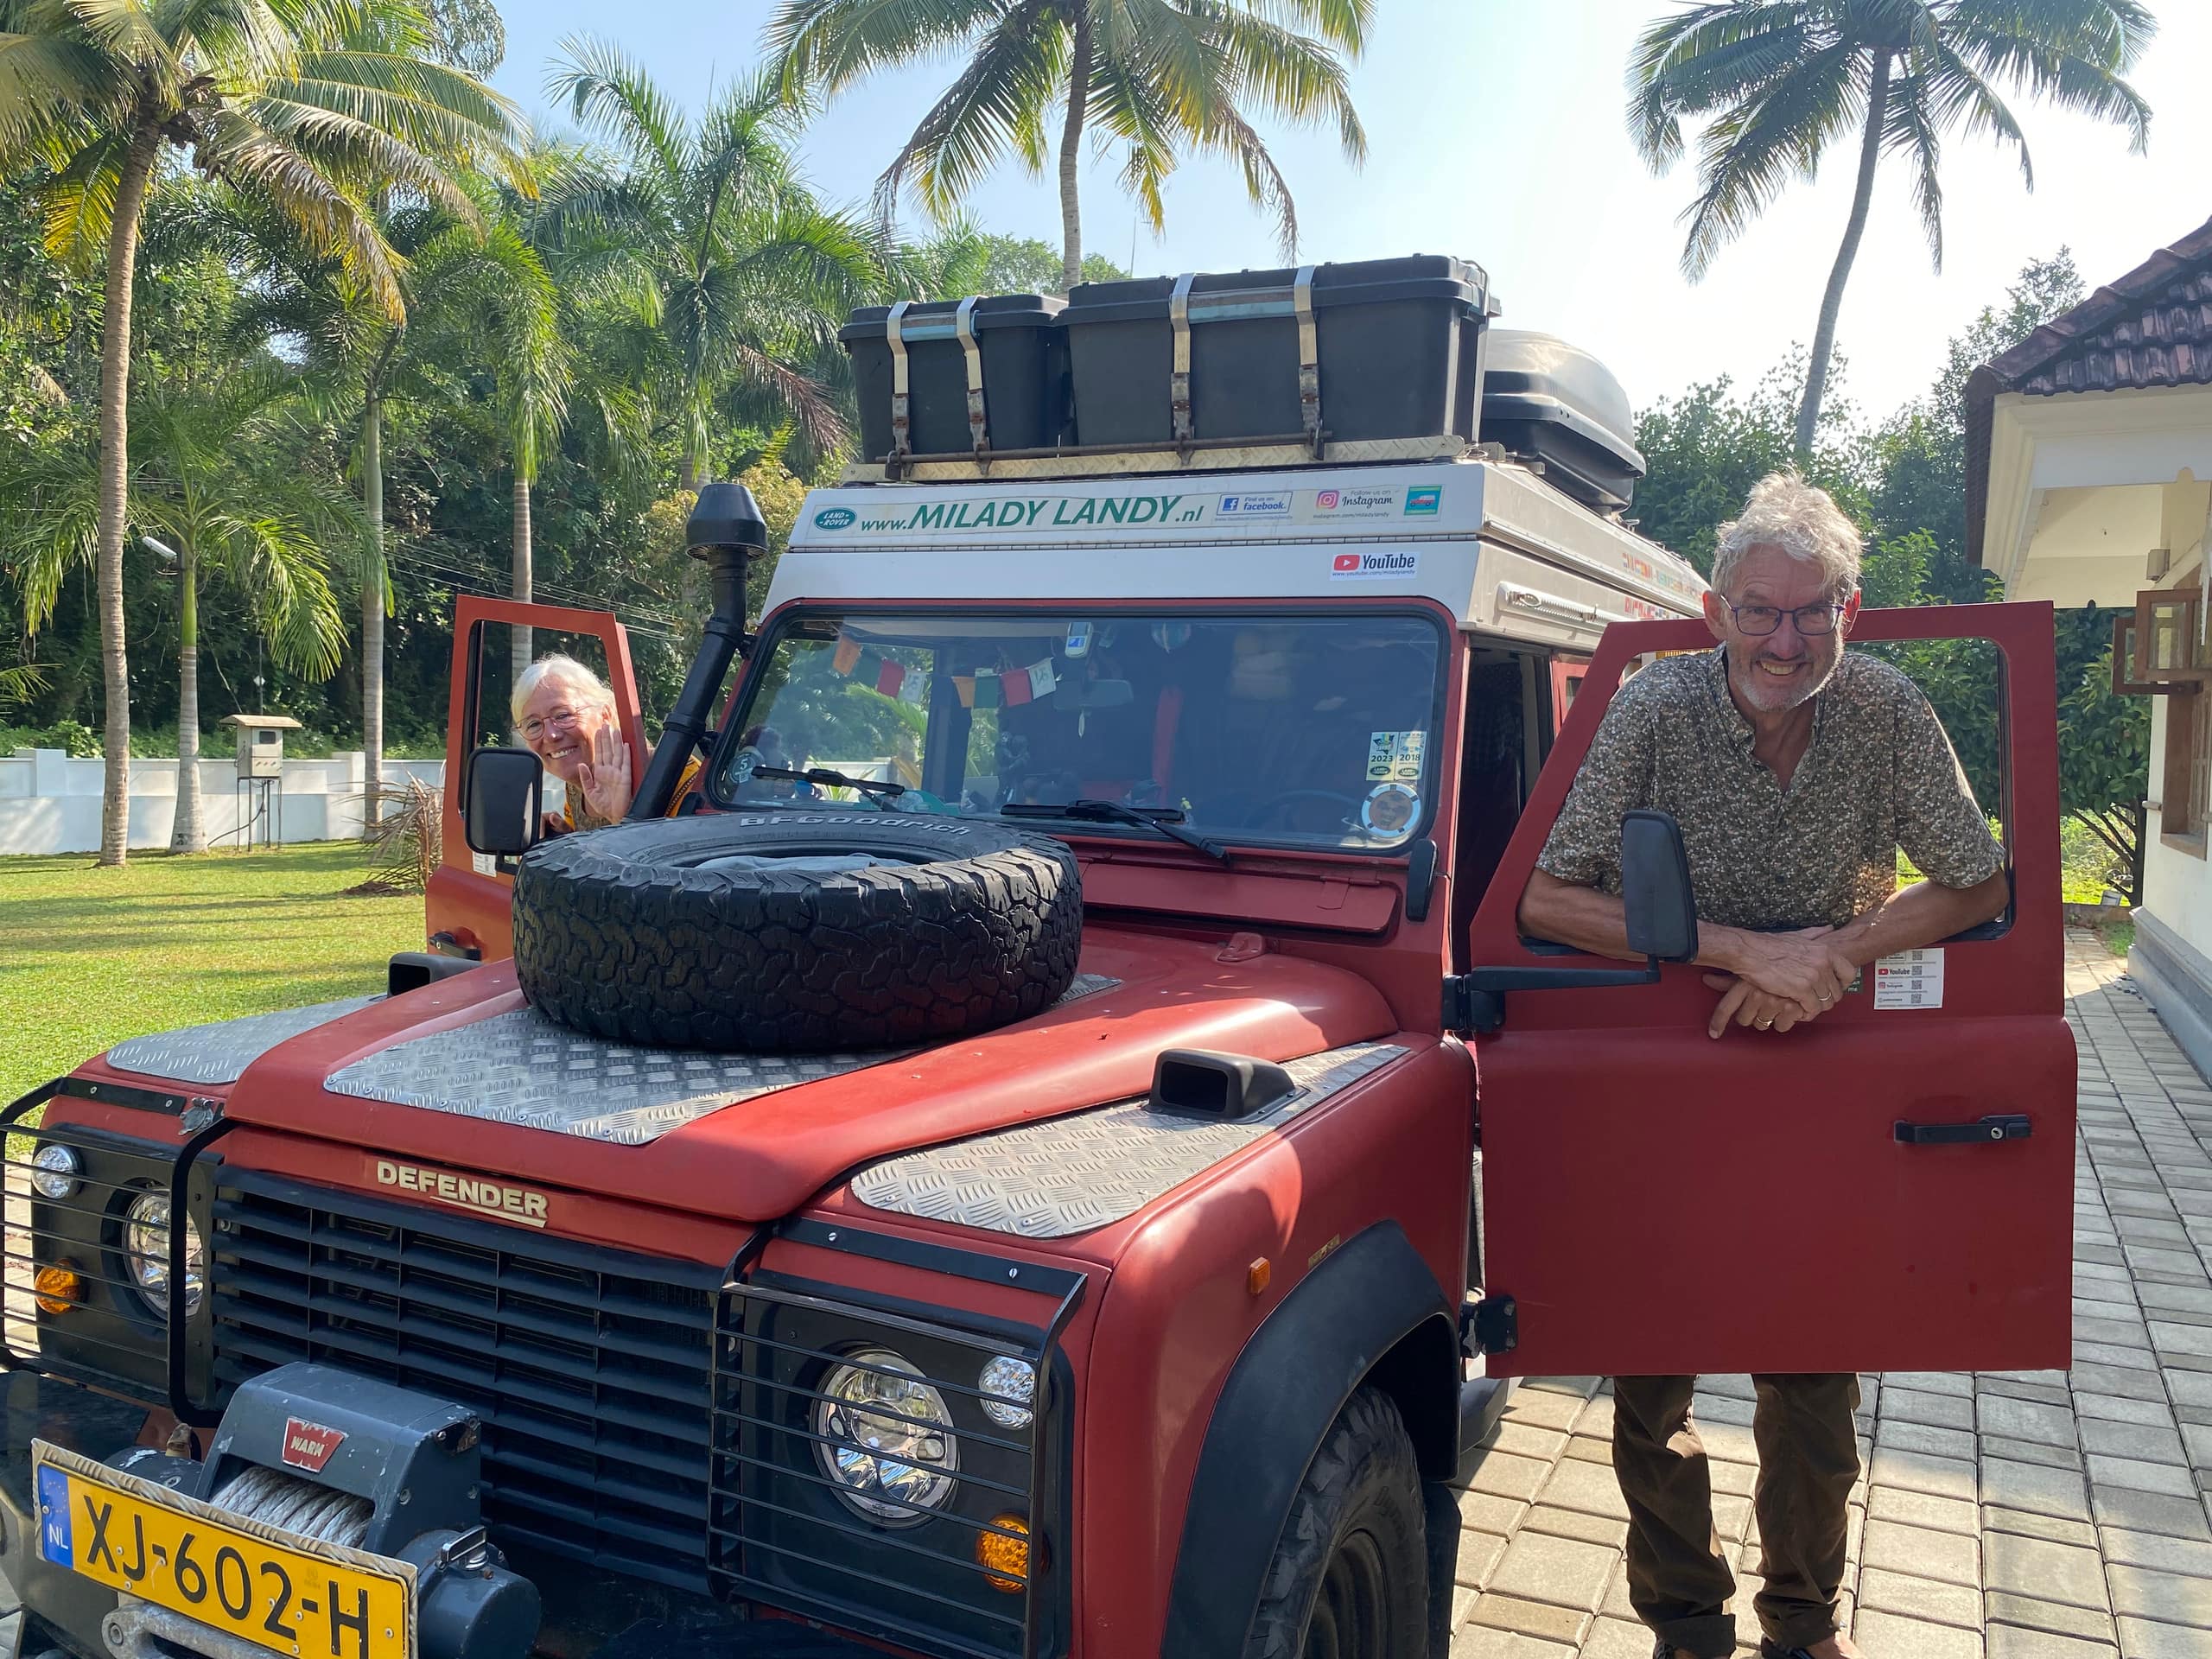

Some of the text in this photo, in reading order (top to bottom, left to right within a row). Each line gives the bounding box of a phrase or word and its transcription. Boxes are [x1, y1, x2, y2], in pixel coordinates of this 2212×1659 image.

[1341, 496, 1393, 509] Instagram
[1363, 553, 1415, 569] YouTube
[740, 816, 972, 836] BFGoodrich
[378, 1160, 550, 1218] DEFENDER
[290, 1435, 325, 1458] WARN
[48, 1524, 69, 1551] NL
[83, 1495, 369, 1659] XJ-602-H
